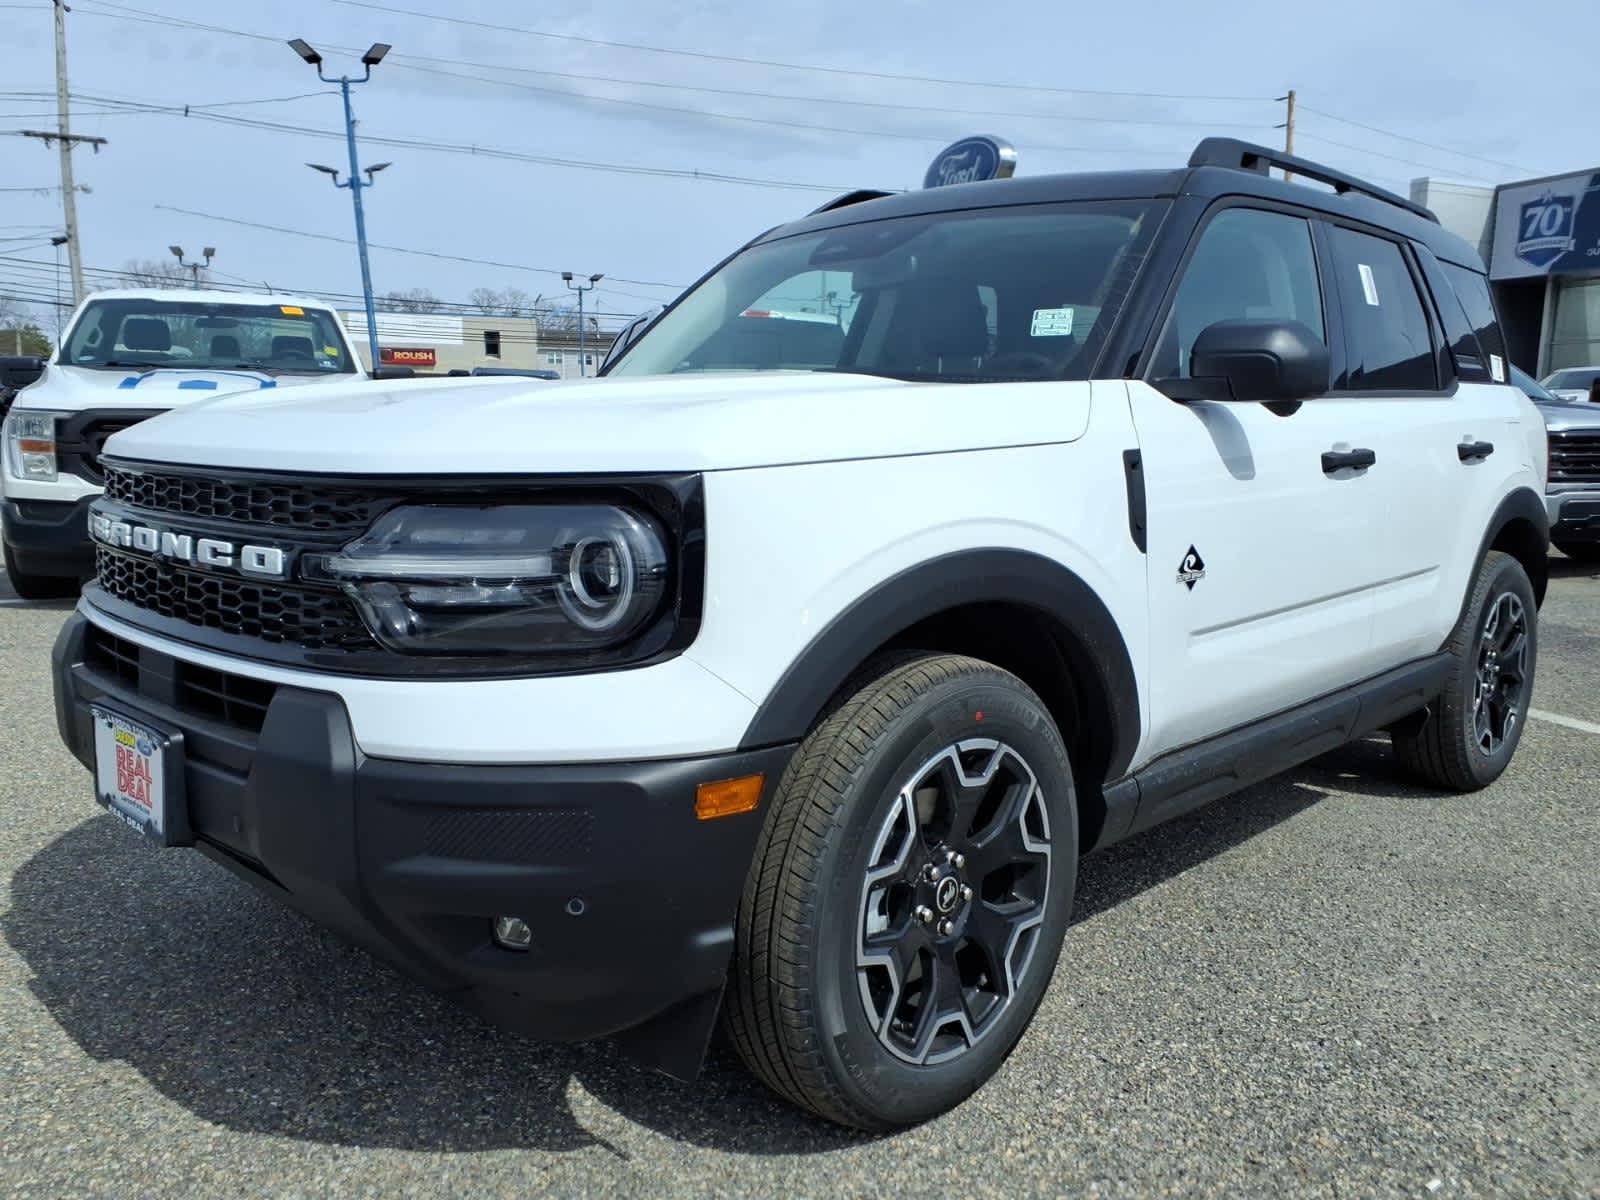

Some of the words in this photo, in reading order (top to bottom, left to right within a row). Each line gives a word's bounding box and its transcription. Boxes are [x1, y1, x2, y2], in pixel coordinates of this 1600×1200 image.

[940, 151, 981, 185] Ford
[394, 351, 433, 360] ROUSH
[87, 511, 283, 575] BRONCO
[115, 743, 152, 785] REAL
[117, 768, 152, 809] DEAL
